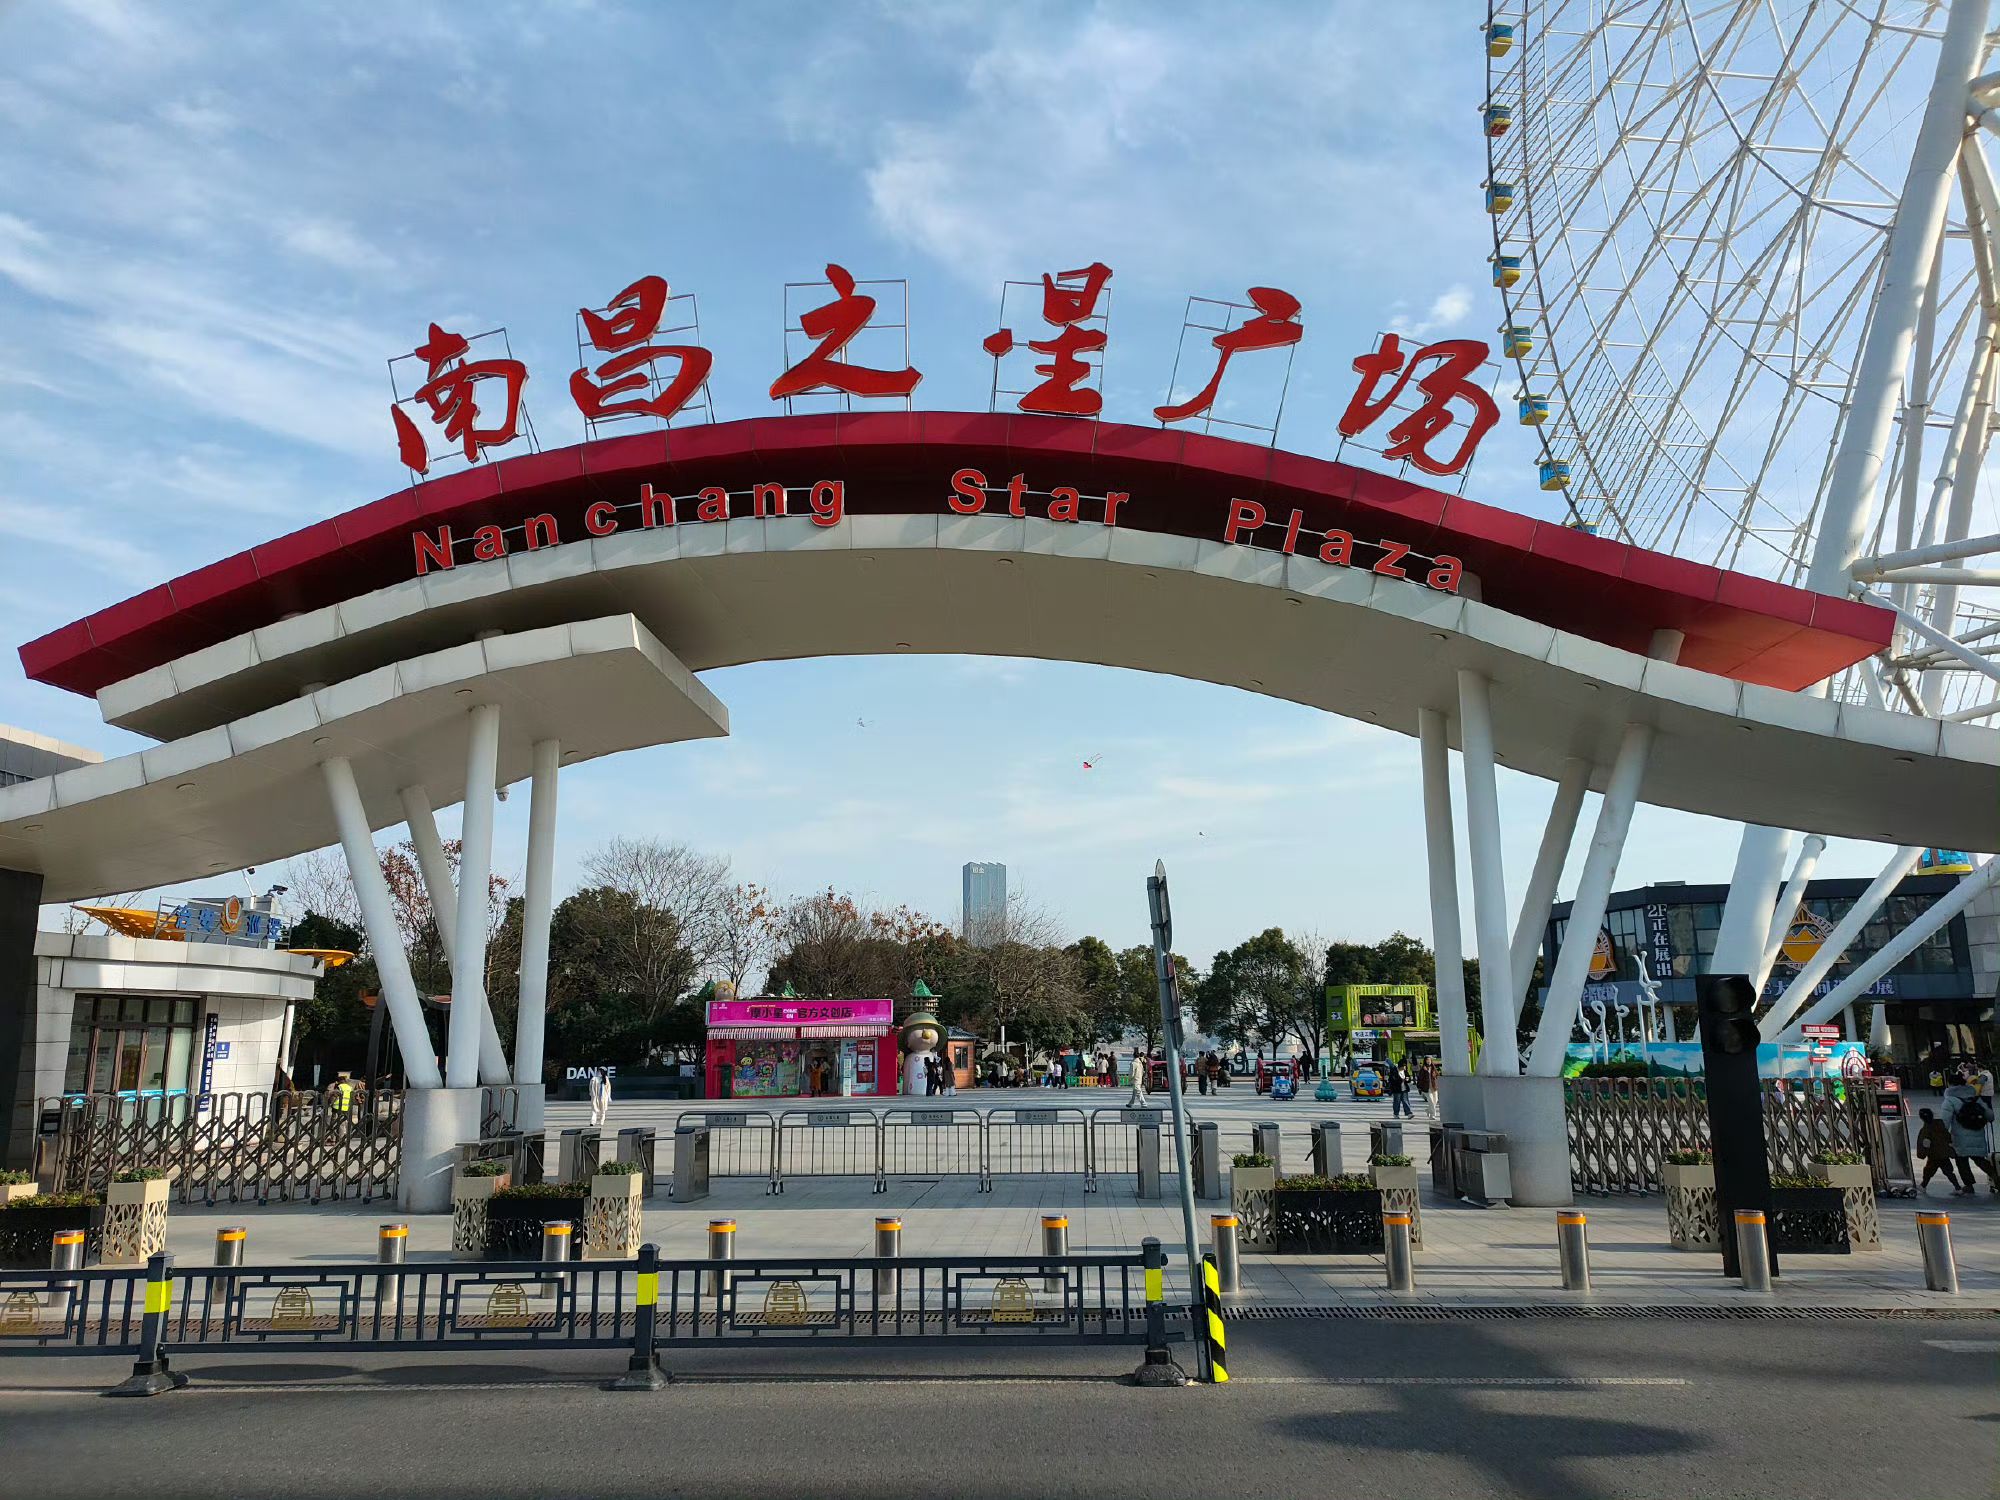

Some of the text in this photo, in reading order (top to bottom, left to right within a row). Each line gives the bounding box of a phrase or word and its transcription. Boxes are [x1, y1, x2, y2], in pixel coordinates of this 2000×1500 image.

[391, 262, 1500, 476] 南昌之星广场
[412, 468, 1464, 594] Nanchang Star Plaza
[1647, 904, 1673, 976] 2F正在展出
[797, 1007, 853, 1018] 官方文创店
